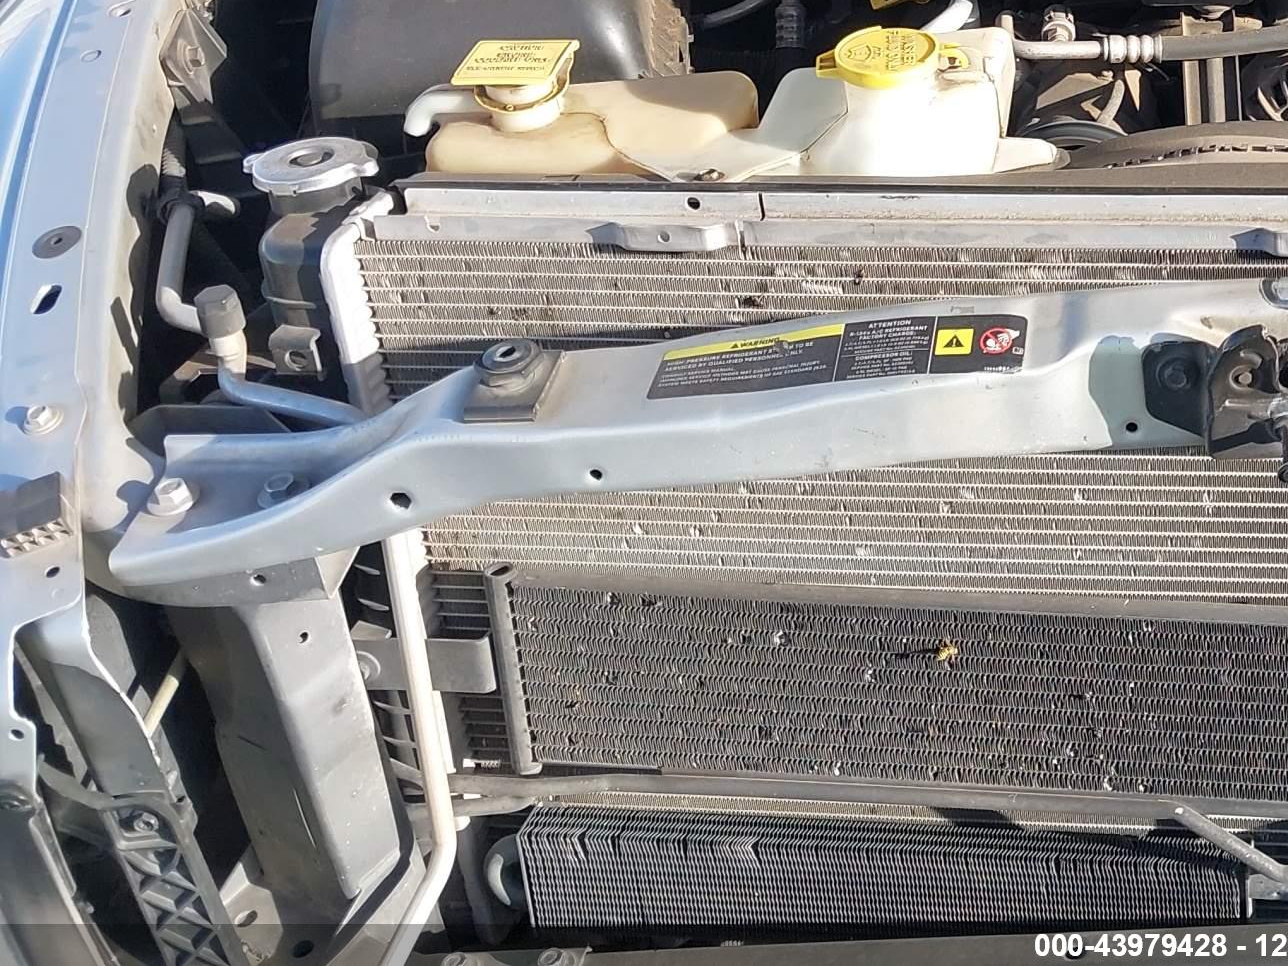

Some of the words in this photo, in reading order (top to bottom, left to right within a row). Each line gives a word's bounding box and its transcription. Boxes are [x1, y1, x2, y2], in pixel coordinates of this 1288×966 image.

[868, 319, 911, 329] ATTENTION
[740, 338, 780, 347] WARNING
[708, 357, 744, 367] QUALIFIED
